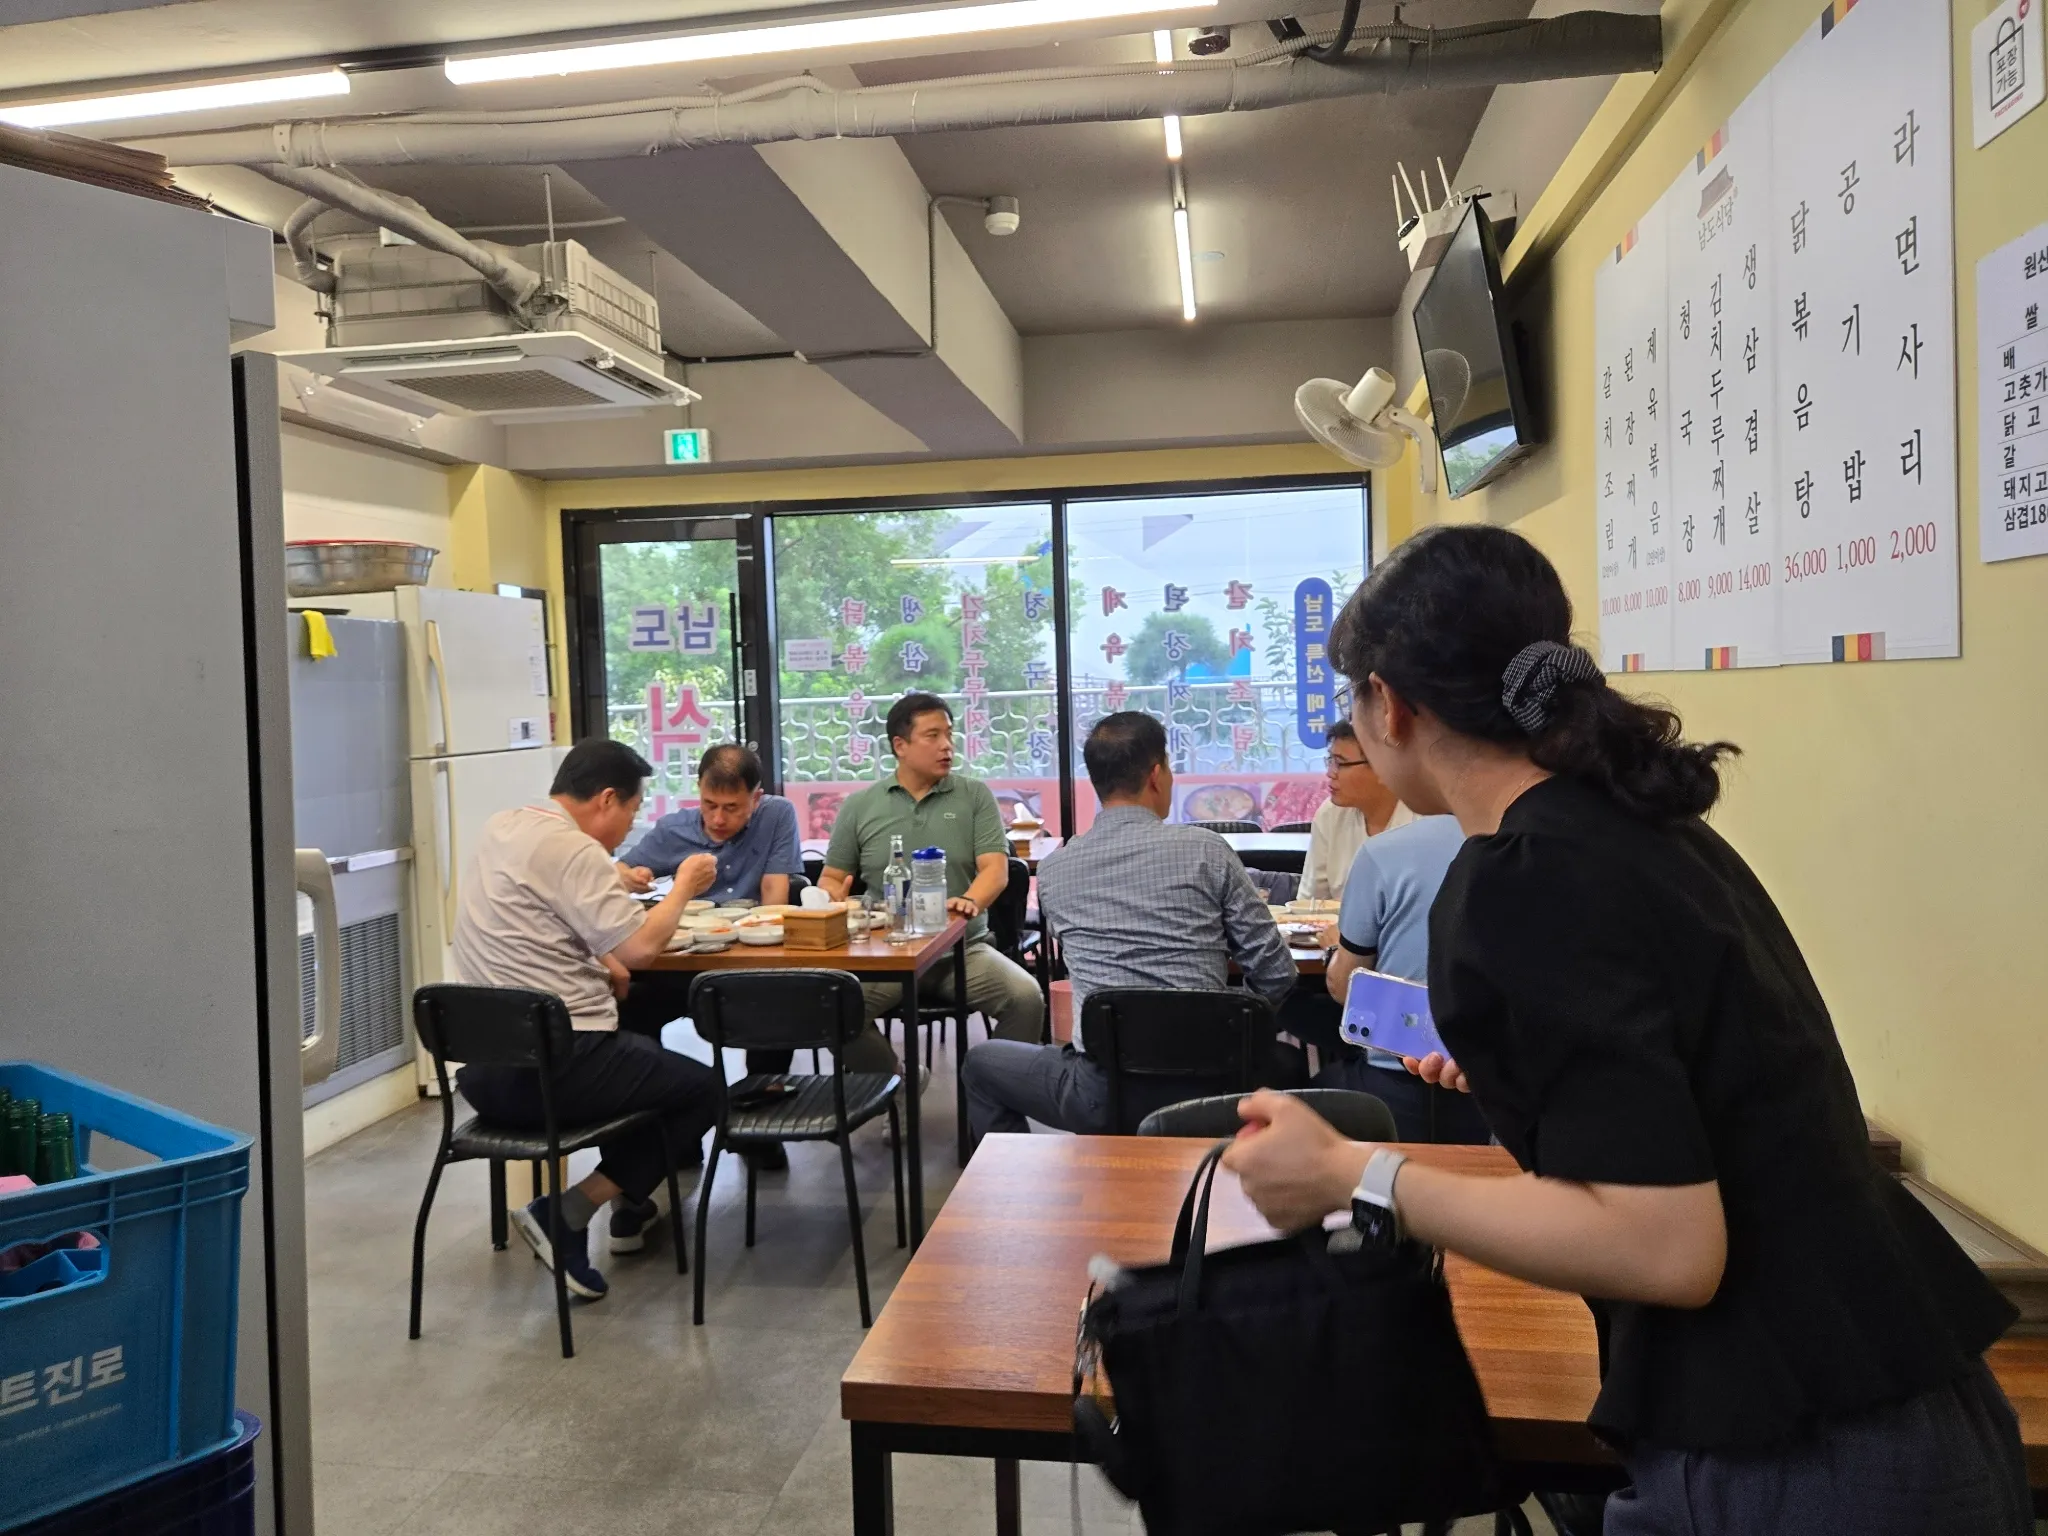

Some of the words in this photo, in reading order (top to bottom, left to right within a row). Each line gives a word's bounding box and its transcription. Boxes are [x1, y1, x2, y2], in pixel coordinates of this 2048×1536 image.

[1996, 45, 2018, 76] 포장
[1996, 68, 2018, 94] 가능
[1994, 92, 2024, 118] PACKAGING
[1698, 196, 1735, 252] 남도식당
[1894, 109, 1924, 485] 라면사리
[1837, 160, 1866, 503] 공기밥
[2025, 303, 2039, 330] 쌀
[1790, 200, 1815, 519] 닭볶음탕
[2003, 346, 2016, 369] 배
[1742, 244, 1762, 535] 생삼겹살
[1709, 273, 1726, 546] 김치두루찌개
[1680, 300, 1696, 553] 청국장
[2003, 444, 2017, 469] 갈
[2003, 470, 2048, 500] 돼지고
[2003, 503, 2048, 532] 삼겹18
[1837, 536, 1876, 573] 1,000
[1889, 521, 1936, 563] 2,000
[1738, 562, 1771, 592] 14,000
[1784, 547, 1827, 583] 36,000
[1645, 585, 1668, 609] 10,000
[1678, 578, 1701, 603] 8,000
[1708, 571, 1733, 598] 9,000
[0, 1345, 127, 1417] 트진로
